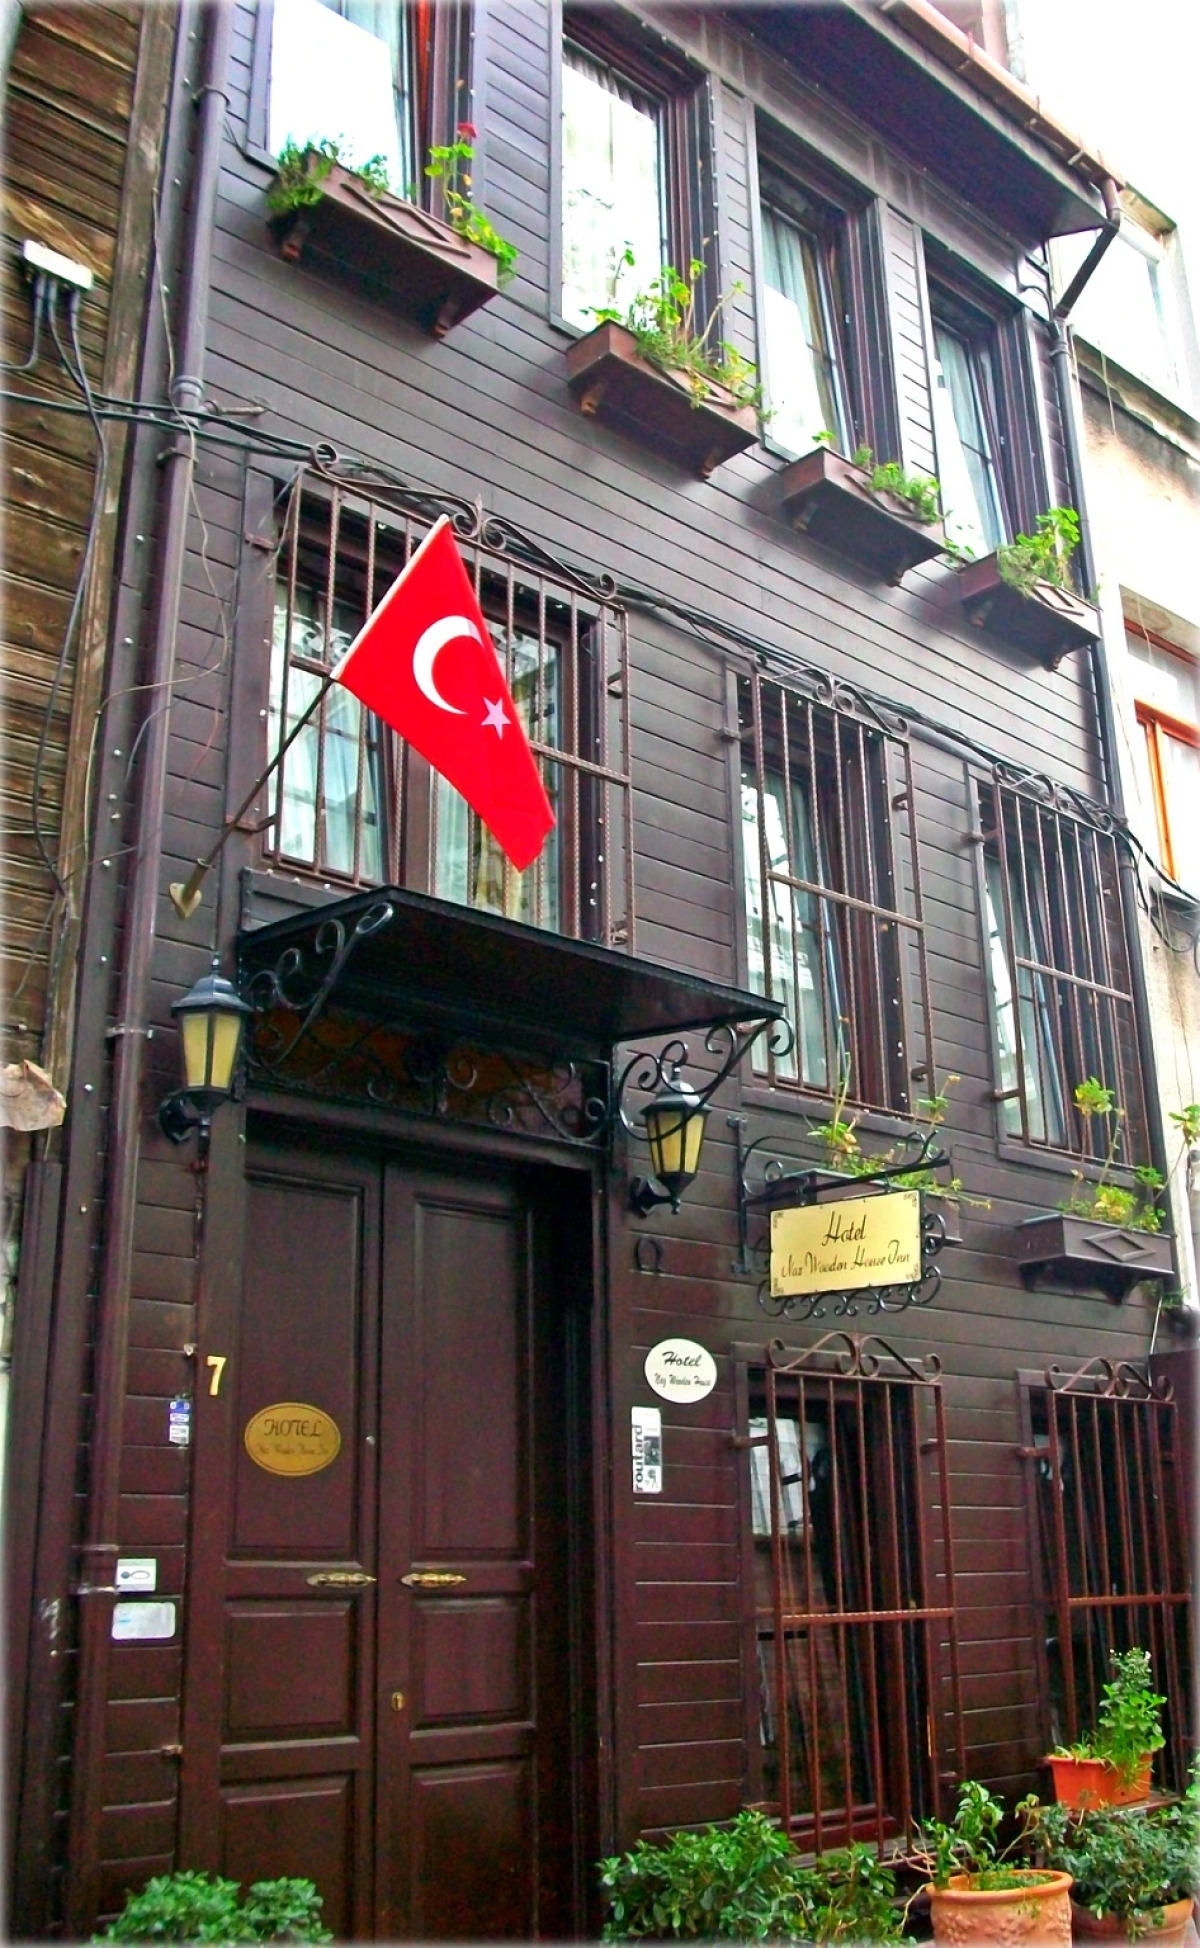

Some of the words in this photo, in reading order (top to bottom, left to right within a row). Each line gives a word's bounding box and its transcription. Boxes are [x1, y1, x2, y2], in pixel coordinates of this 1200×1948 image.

[821, 1210, 867, 1246] Hotel
[804, 1251, 847, 1275] Wooden
[850, 1245, 886, 1270] House
[887, 1239, 910, 1265] Inn
[207, 1355, 227, 1396] 7
[662, 1351, 702, 1367] Hotel
[263, 1418, 322, 1437] HOTEL
[632, 1424, 644, 1492] routard
